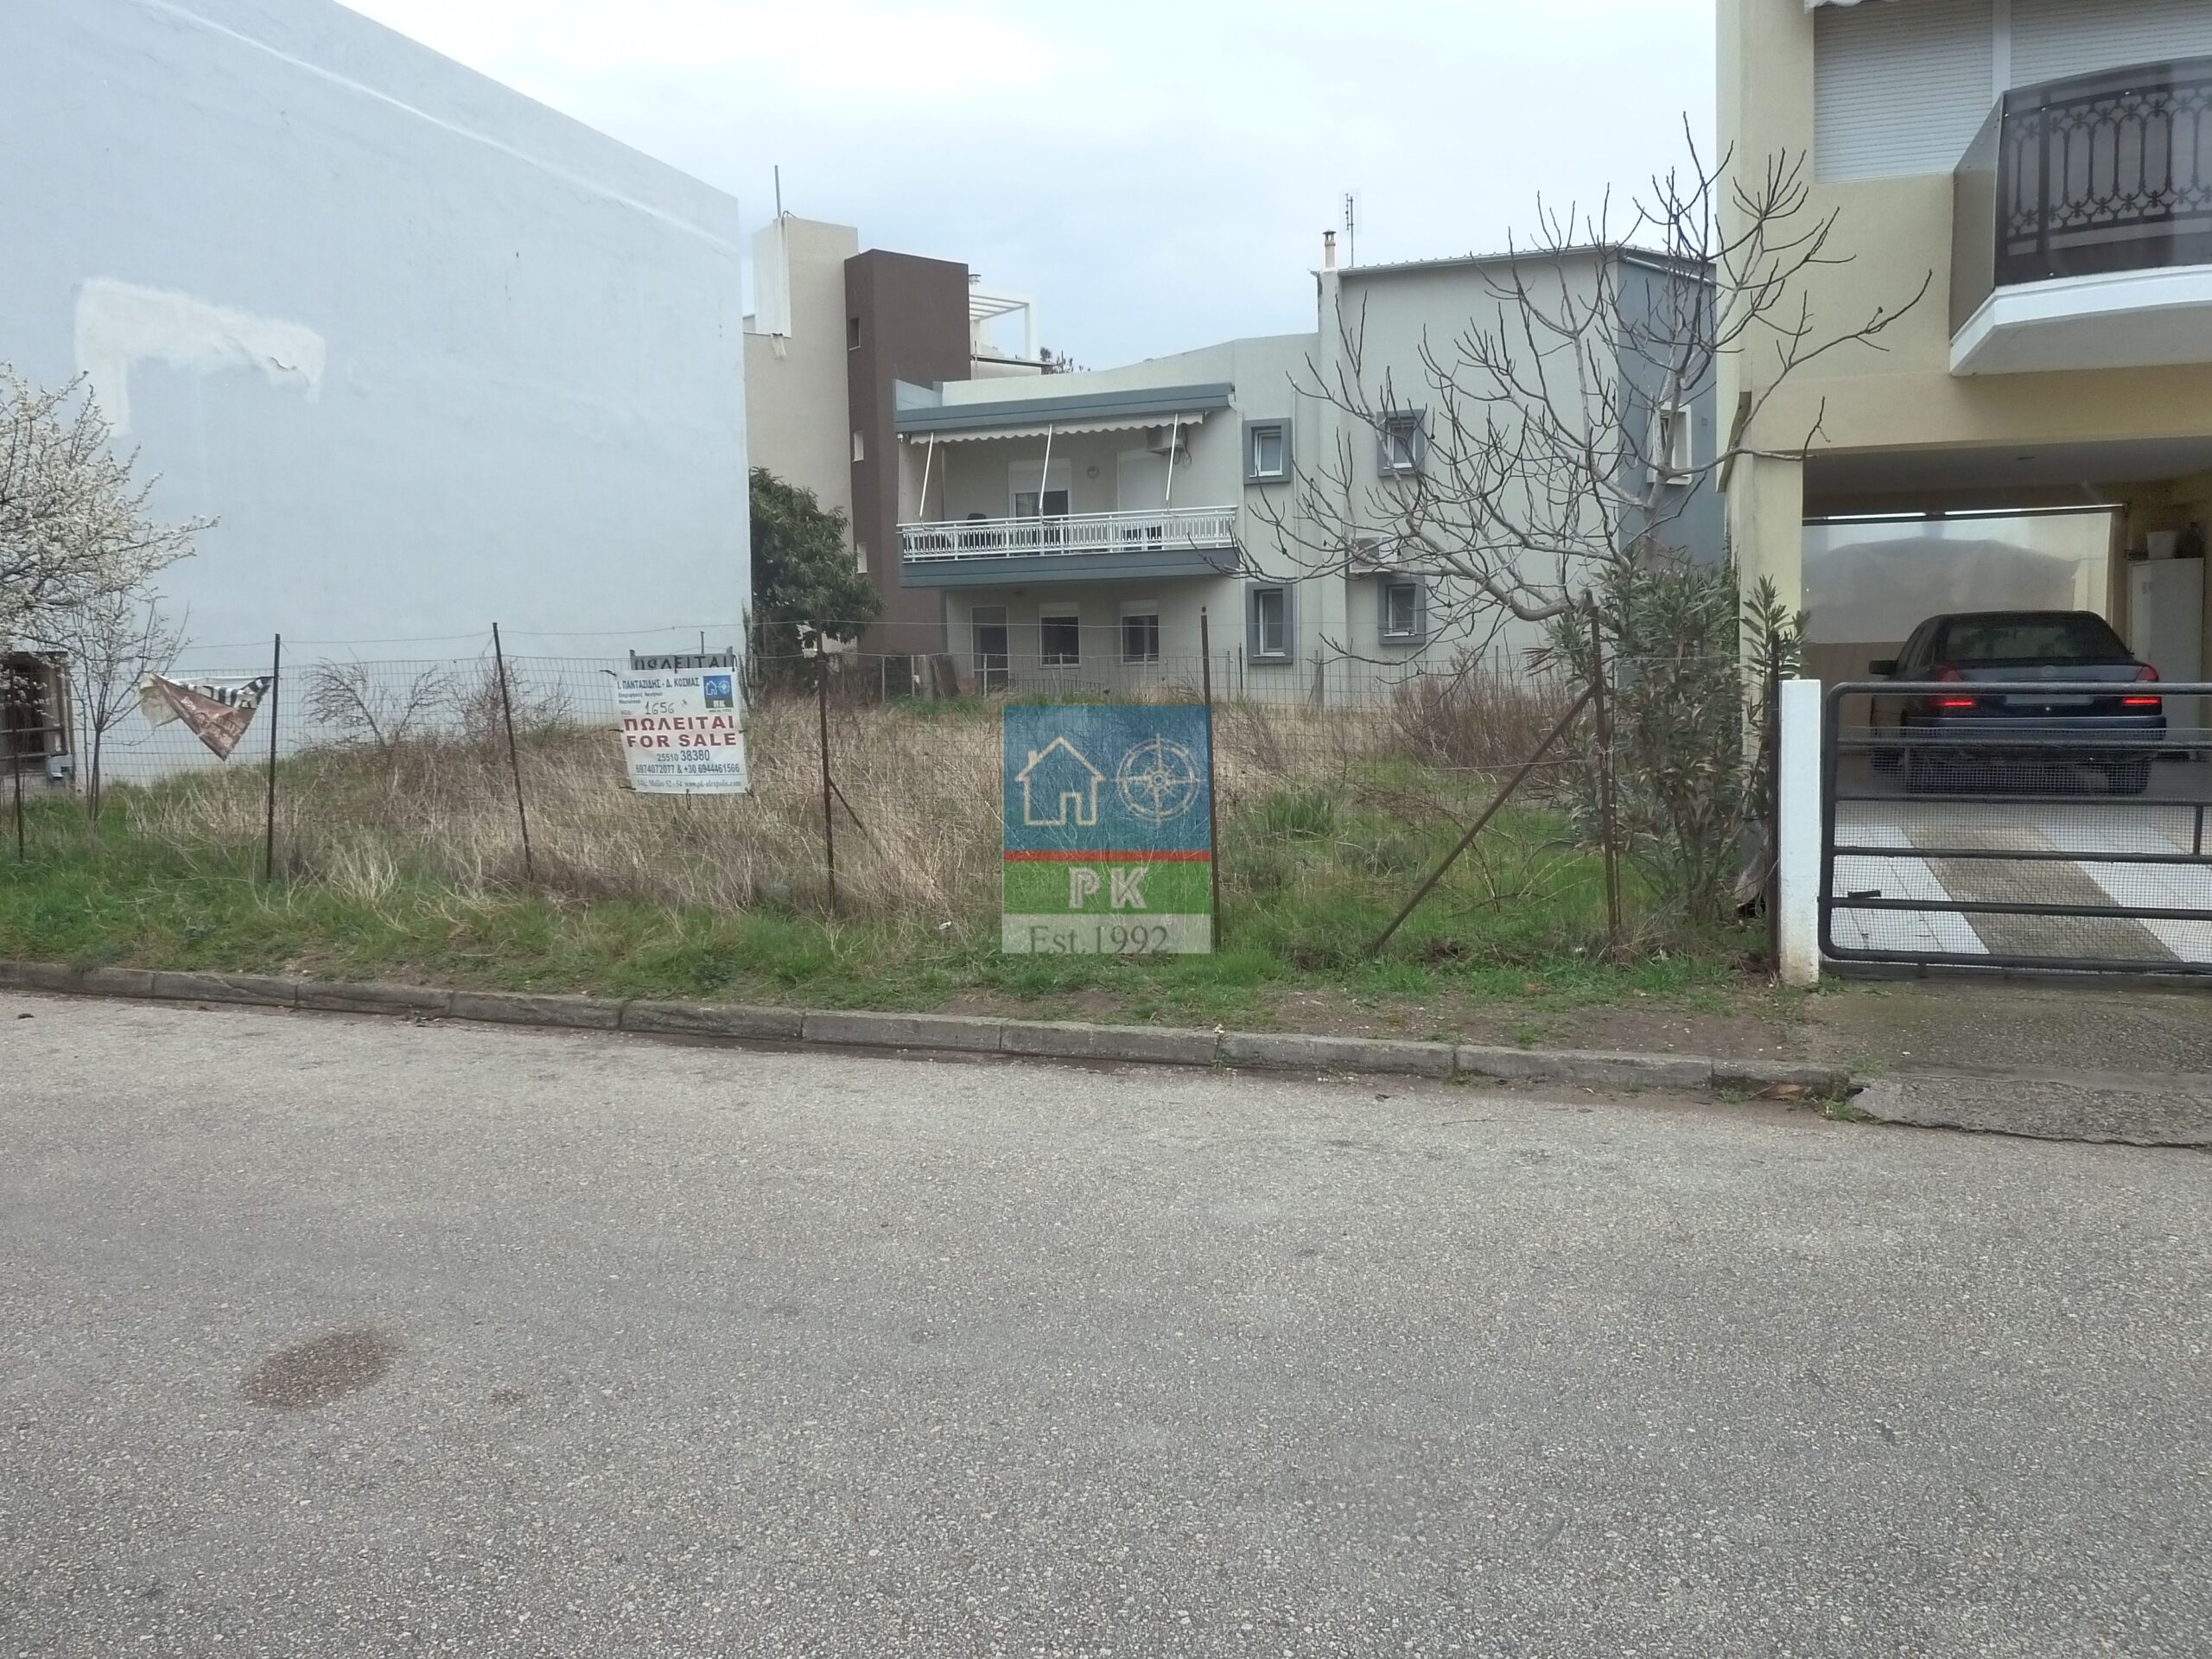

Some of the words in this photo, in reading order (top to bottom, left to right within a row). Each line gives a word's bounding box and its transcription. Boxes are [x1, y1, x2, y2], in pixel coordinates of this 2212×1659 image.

[622, 679, 661, 690] ΠΑΝΤΑΖΙΔΗΣ
[666, 678, 673, 688] Δ.
[674, 677, 700, 687] ΚΟΣΜΑΣ
[624, 715, 734, 731] ΠΩΛΕΙΤΑΙ
[626, 734, 671, 748] FOR
[678, 733, 736, 747] SALE
[657, 753, 678, 762] 25510
[680, 749, 710, 762] 38380
[677, 765, 683, 773] &
[683, 764, 696, 773] +30
